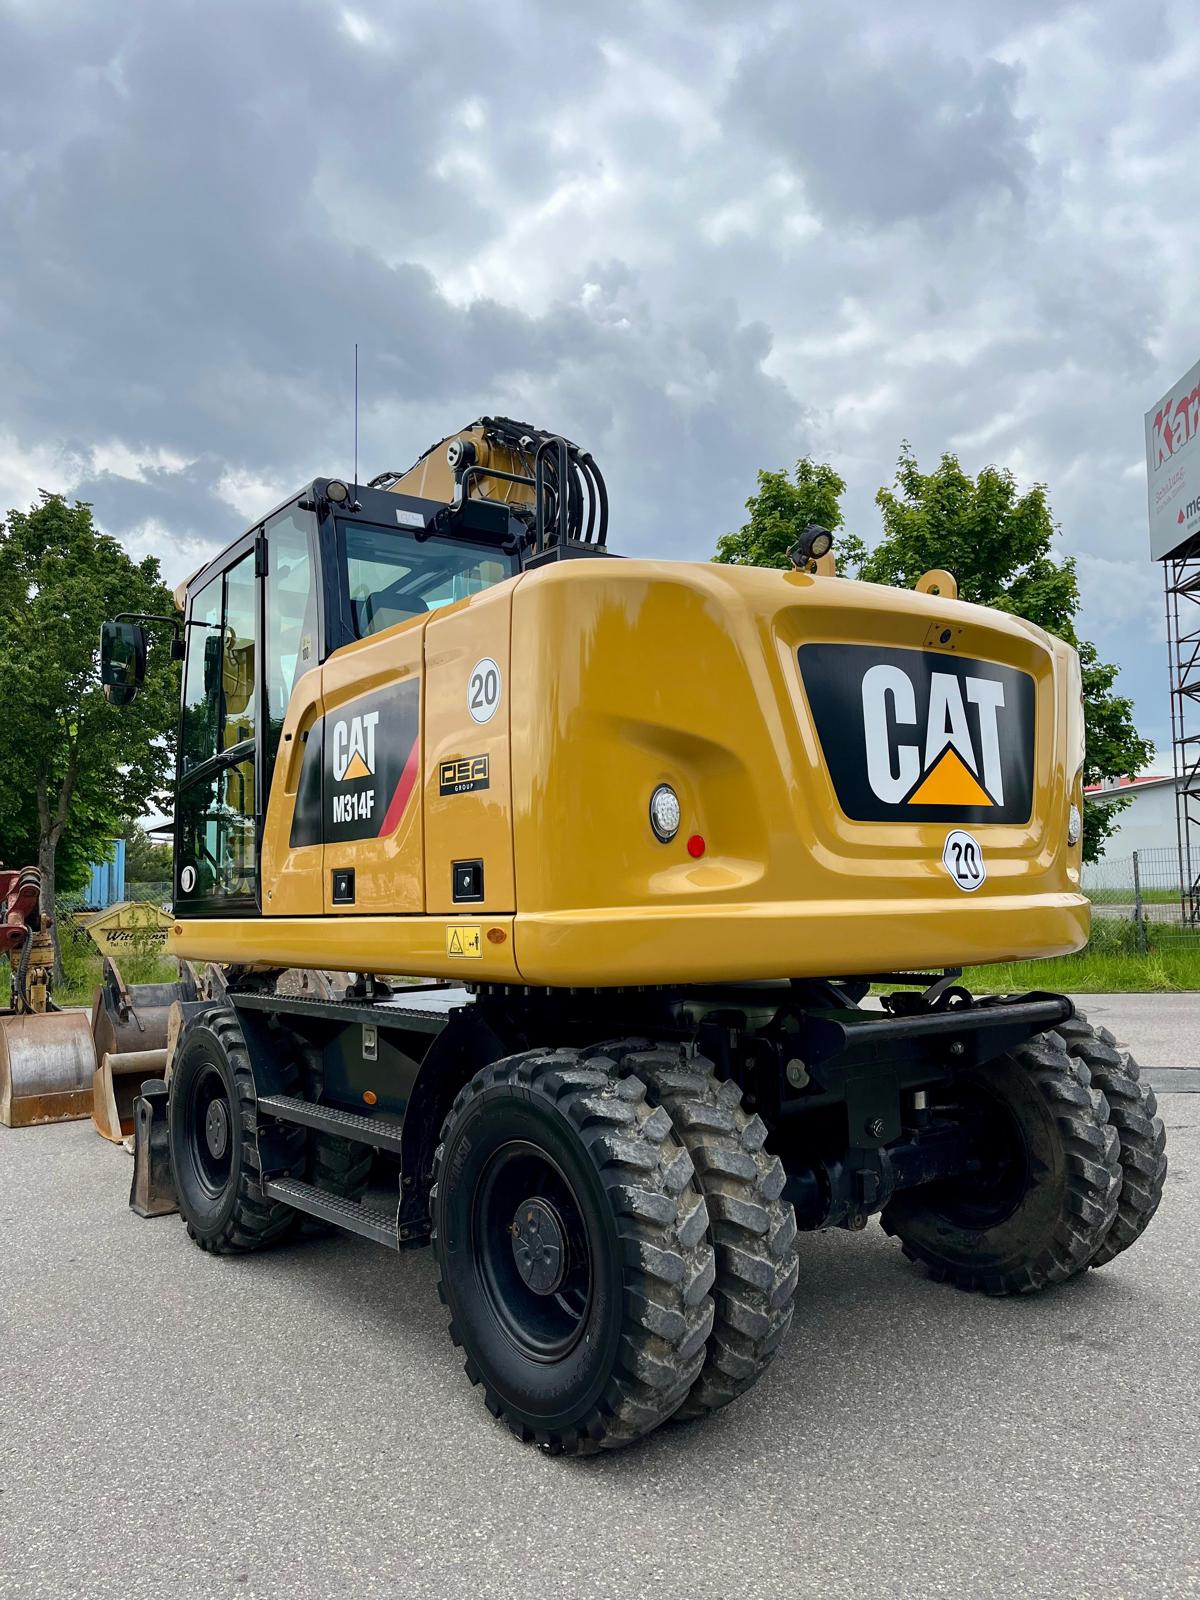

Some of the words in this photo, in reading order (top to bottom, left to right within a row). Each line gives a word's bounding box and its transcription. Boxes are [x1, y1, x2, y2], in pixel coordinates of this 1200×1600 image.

[1153, 385, 1200, 471] Kar
[470, 669, 498, 709] 20
[333, 711, 380, 782] CAT
[862, 664, 1005, 807] CAT
[333, 790, 375, 823] M314F
[454, 783, 474, 792] GROUP
[951, 842, 980, 880] 20
